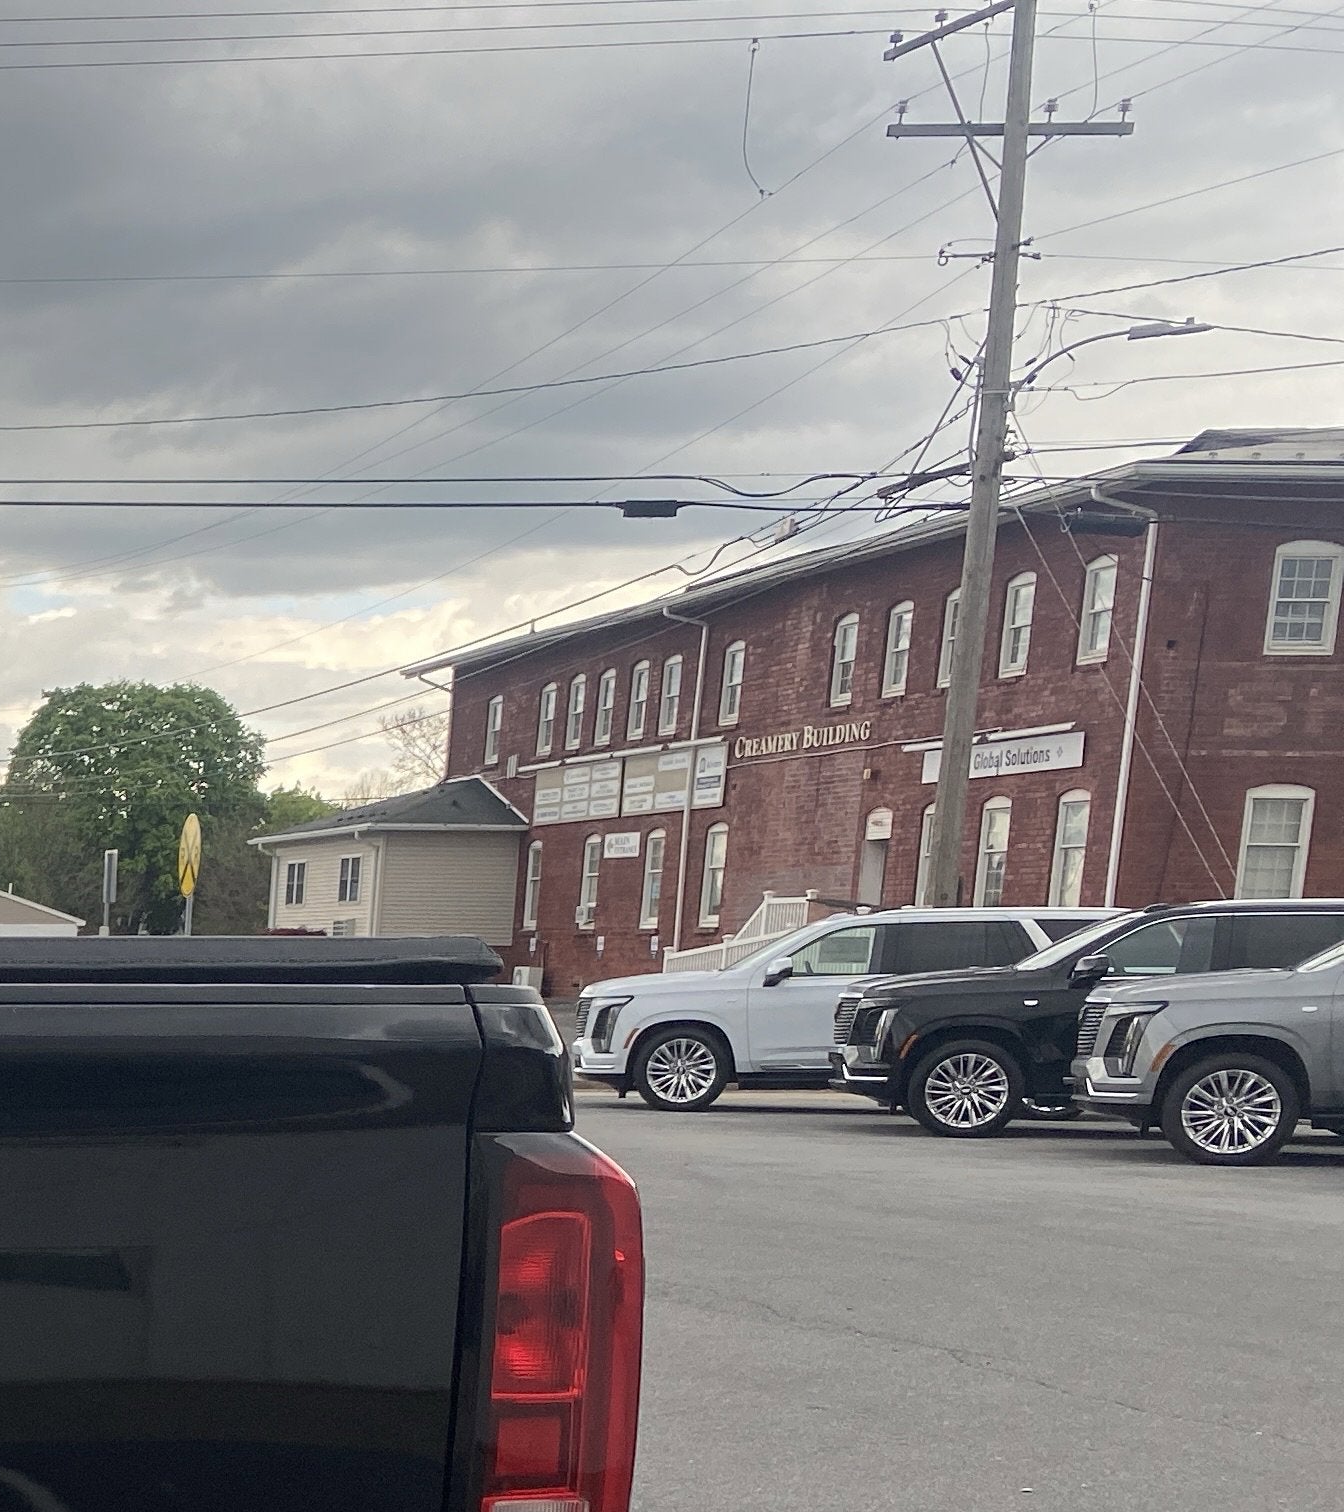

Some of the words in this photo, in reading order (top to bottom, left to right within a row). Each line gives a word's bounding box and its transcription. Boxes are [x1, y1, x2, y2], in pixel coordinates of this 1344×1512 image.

[735, 731, 800, 758] CREAMERY
[802, 721, 872, 749] BUILDING
[973, 749, 1003, 770] Global
[1005, 746, 1051, 767] Solutions
